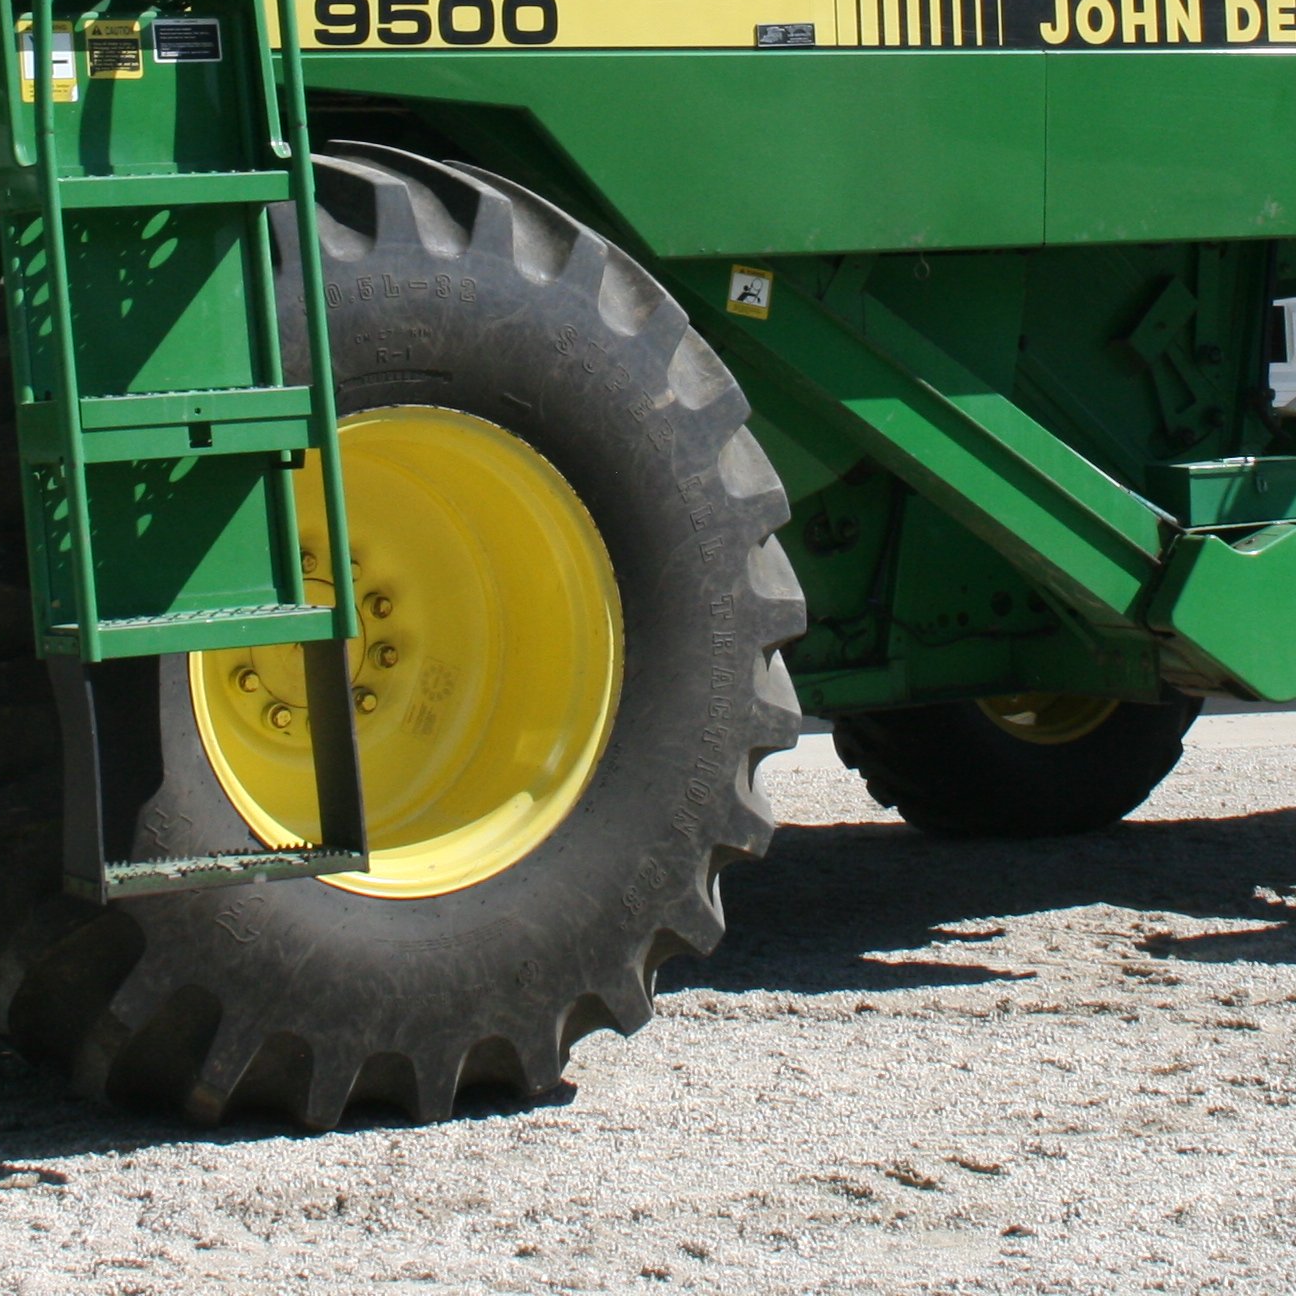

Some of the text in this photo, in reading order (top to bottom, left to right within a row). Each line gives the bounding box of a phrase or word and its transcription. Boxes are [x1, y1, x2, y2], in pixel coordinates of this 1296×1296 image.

[104, 25, 135, 35] CAUTION
[298, 273, 478, 315] 0.5L-32
[677, 475, 724, 563] ALL
[670, 593, 736, 843] TRACTION
